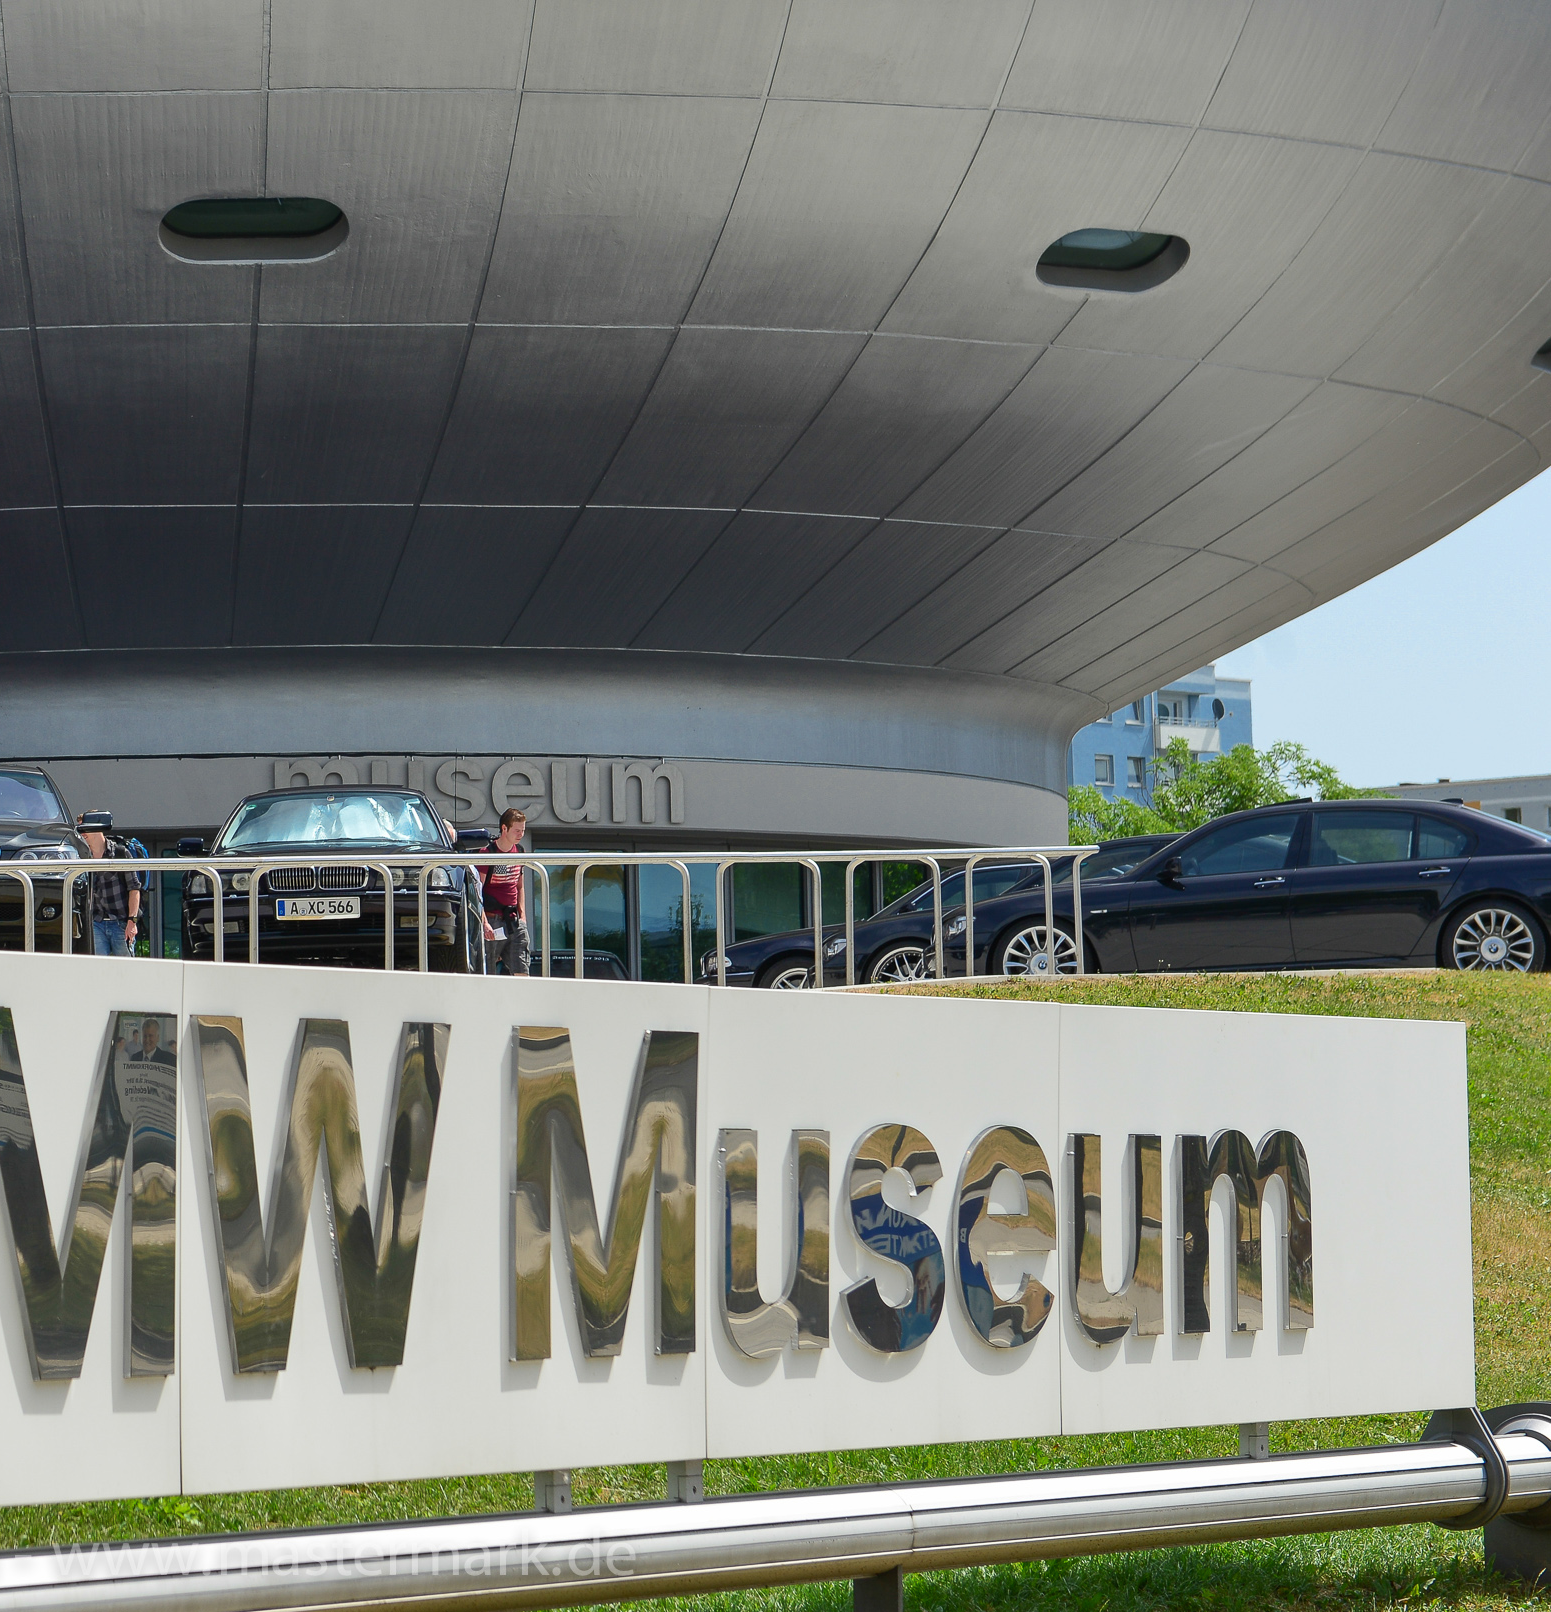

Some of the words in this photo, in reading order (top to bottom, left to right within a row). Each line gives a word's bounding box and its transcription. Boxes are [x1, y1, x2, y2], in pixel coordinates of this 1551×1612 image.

[290, 901, 299, 914] A
[308, 901, 325, 914] XC
[328, 900, 354, 913] 566
[509, 1025, 1314, 1362] Museum
